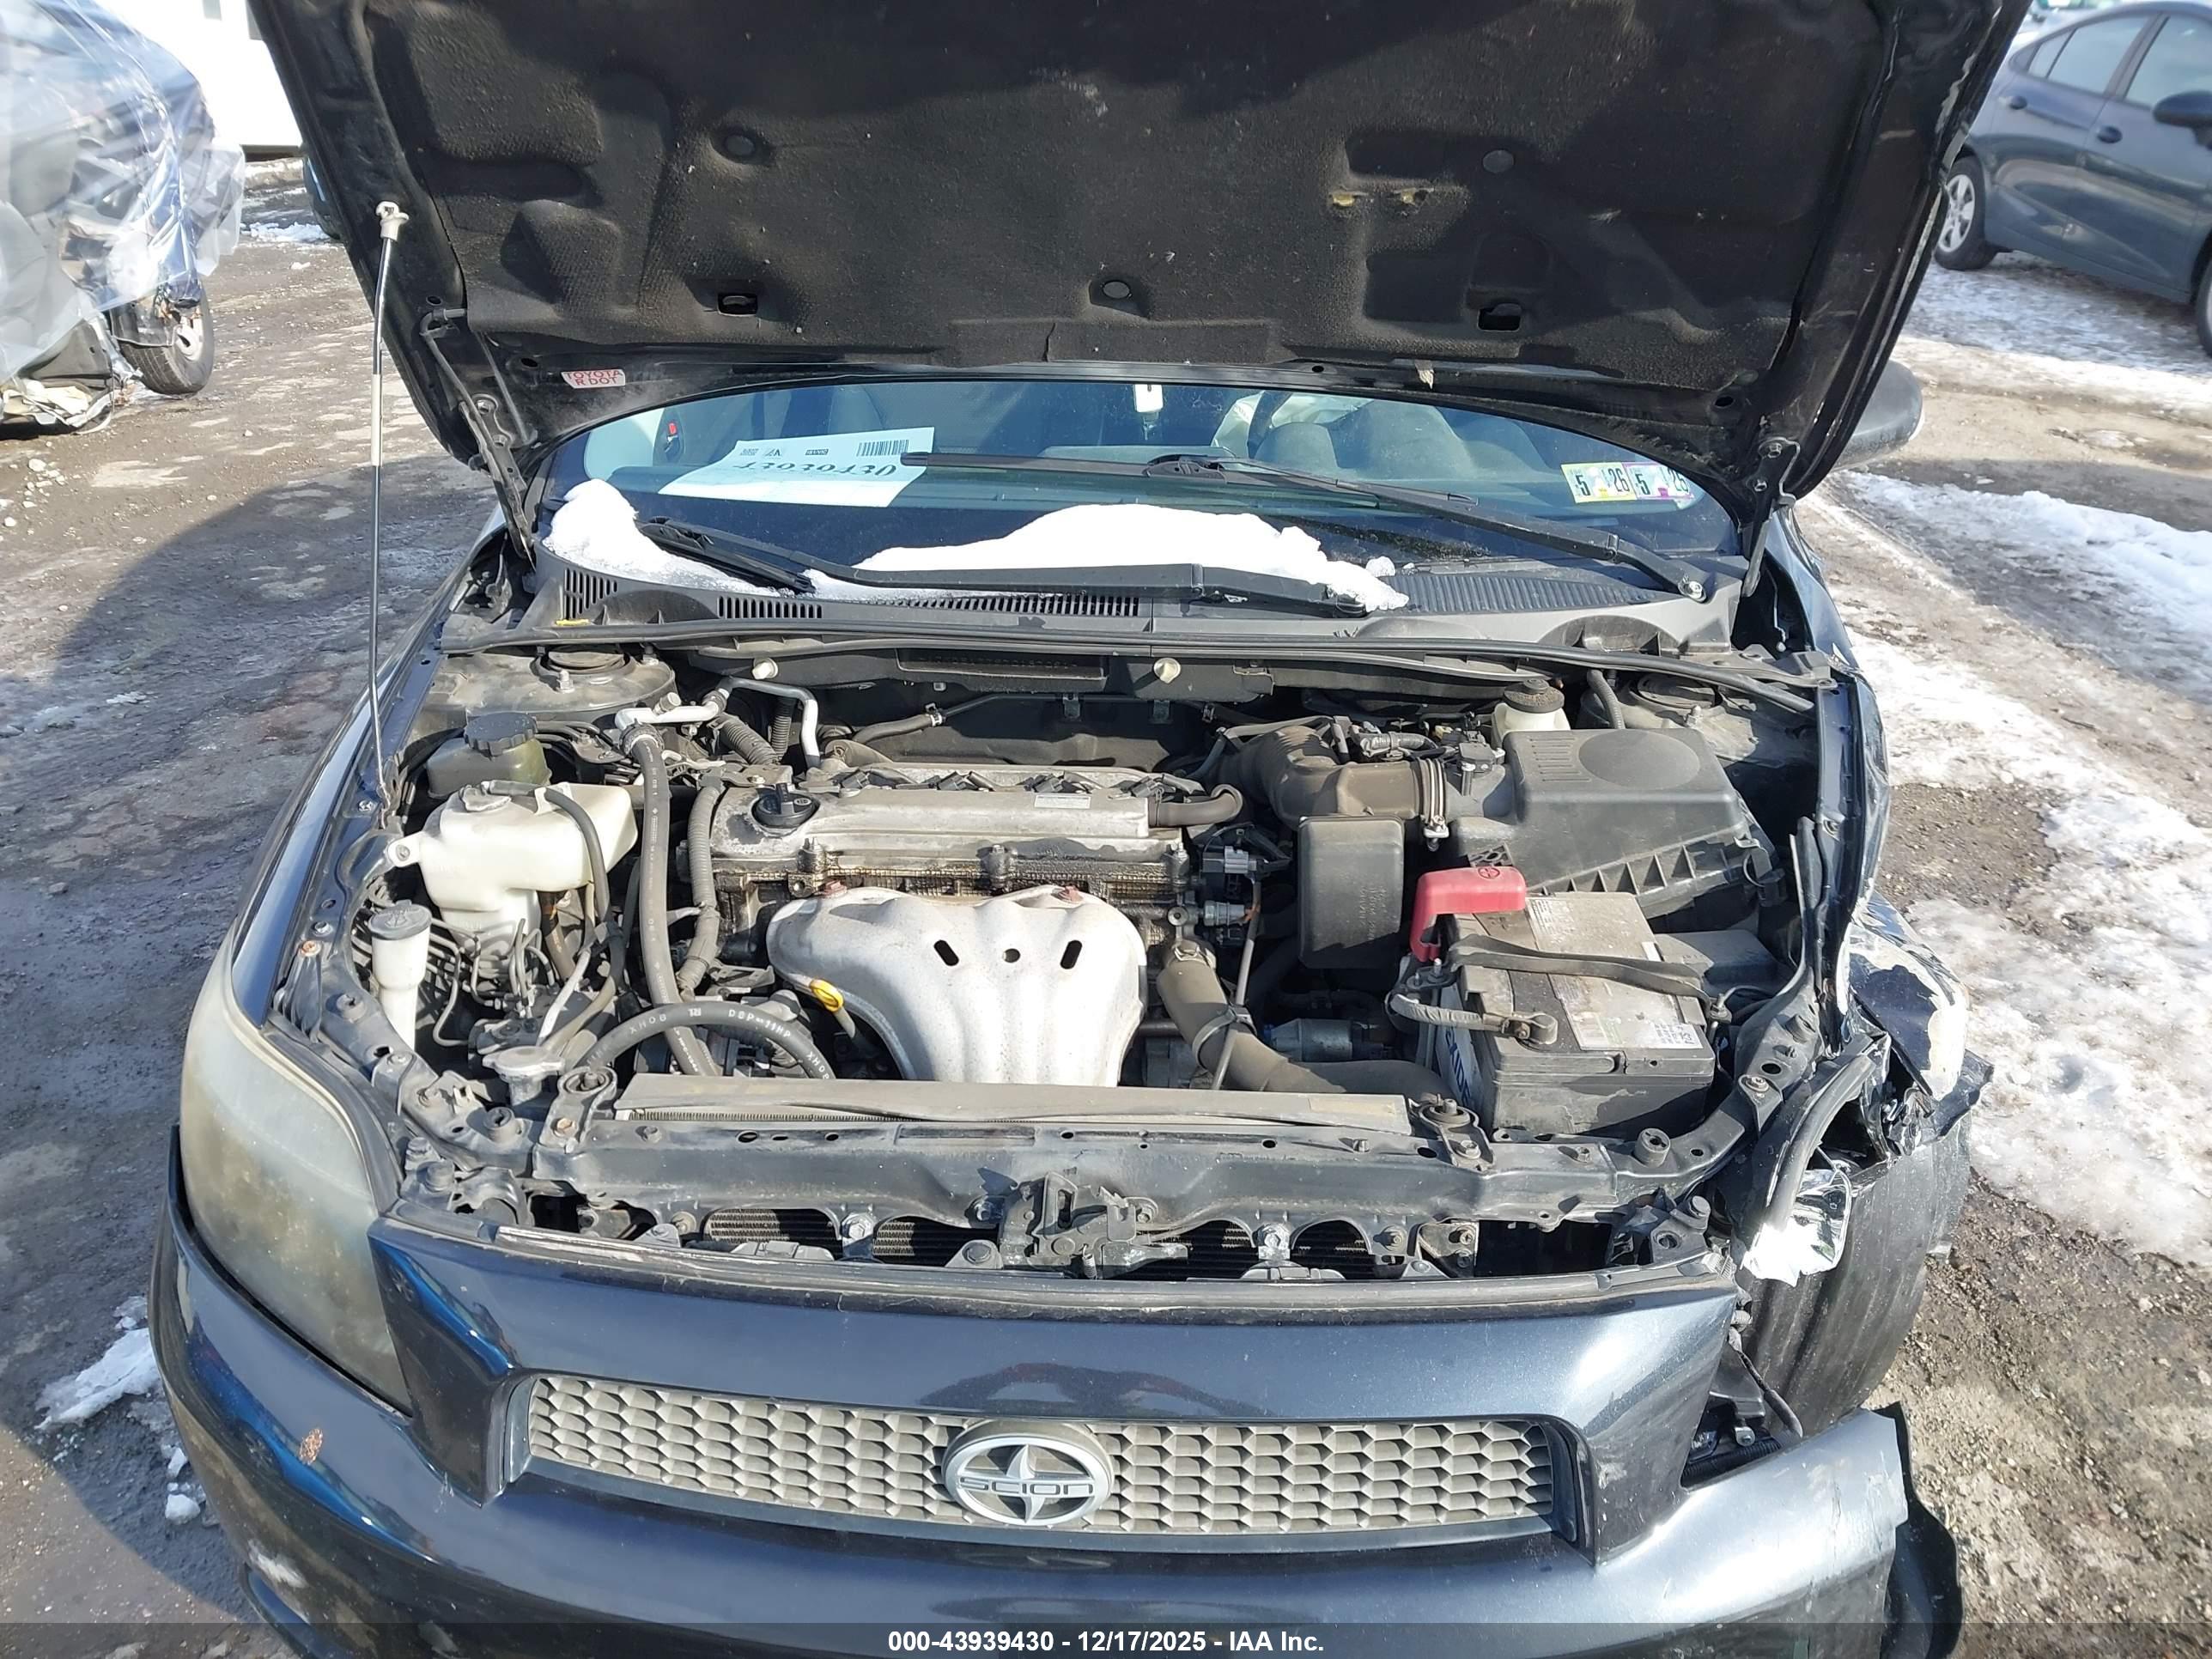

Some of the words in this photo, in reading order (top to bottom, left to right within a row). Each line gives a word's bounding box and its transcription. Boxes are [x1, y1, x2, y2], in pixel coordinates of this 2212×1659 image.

[564, 370, 623, 380] TOYOTA
[588, 377, 617, 386] DOT
[1575, 474, 1591, 496] 5
[1607, 467, 1631, 492] 26
[1635, 473, 1651, 495] 5
[959, 1476, 1094, 1498] SCION
